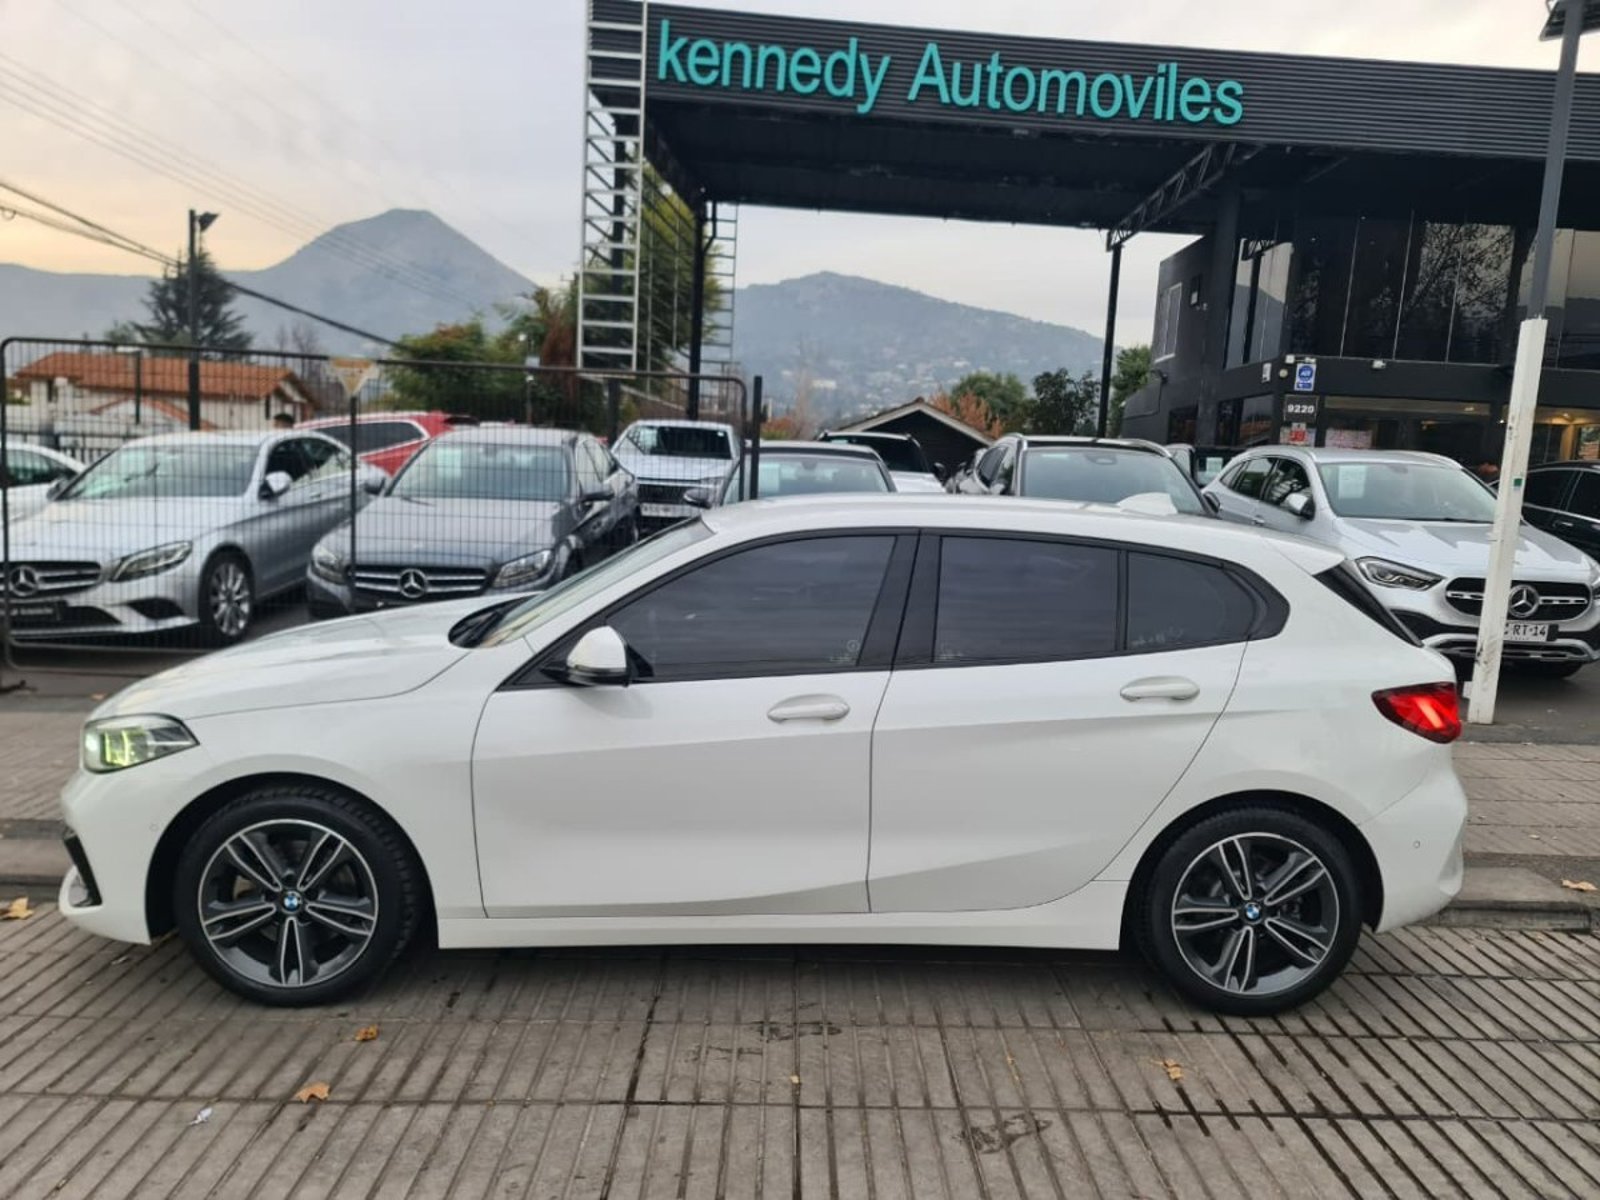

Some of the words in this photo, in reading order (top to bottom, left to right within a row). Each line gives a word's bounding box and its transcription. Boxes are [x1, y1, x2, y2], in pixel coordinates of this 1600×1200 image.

[658, 19, 890, 114] kennedy
[907, 43, 1243, 125] Automoviles
[1287, 404, 1315, 414] 9220
